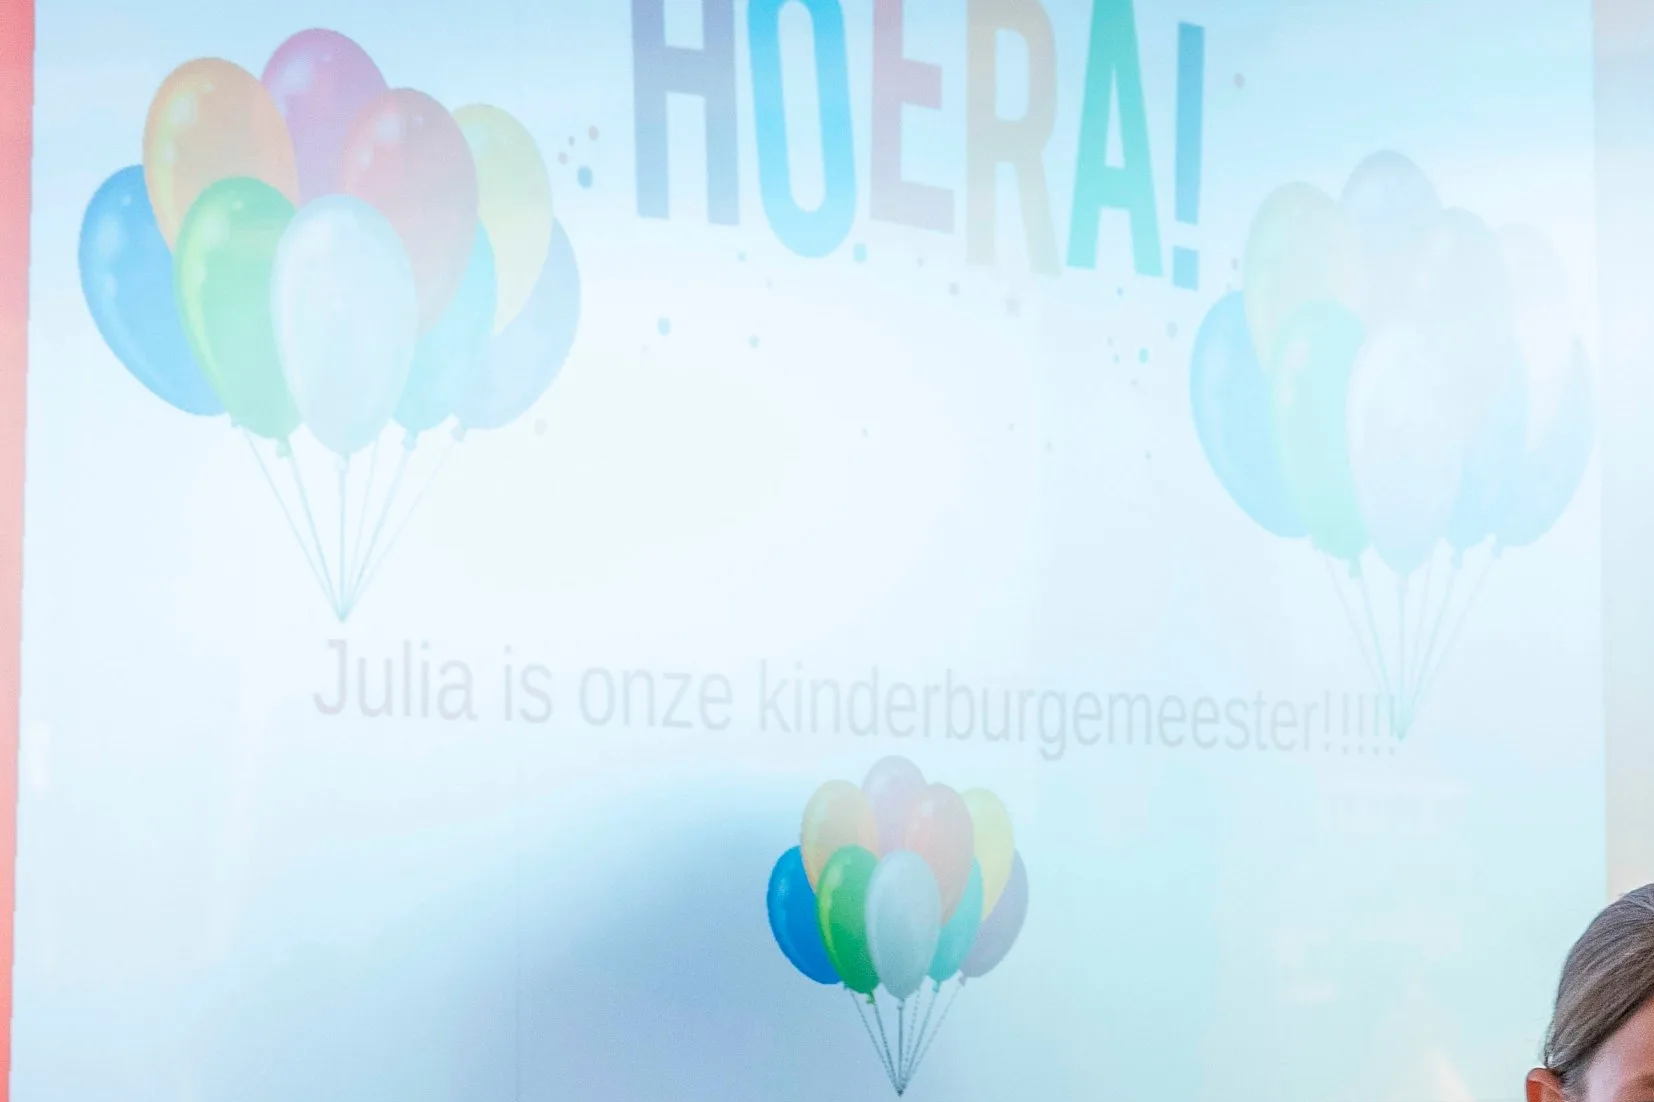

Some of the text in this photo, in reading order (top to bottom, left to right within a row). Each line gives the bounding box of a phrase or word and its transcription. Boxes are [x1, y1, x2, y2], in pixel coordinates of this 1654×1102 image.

[631, 0, 1205, 291] HOERA!
[313, 638, 478, 720] Julia
[503, 644, 554, 724] is
[578, 664, 734, 731] onze
